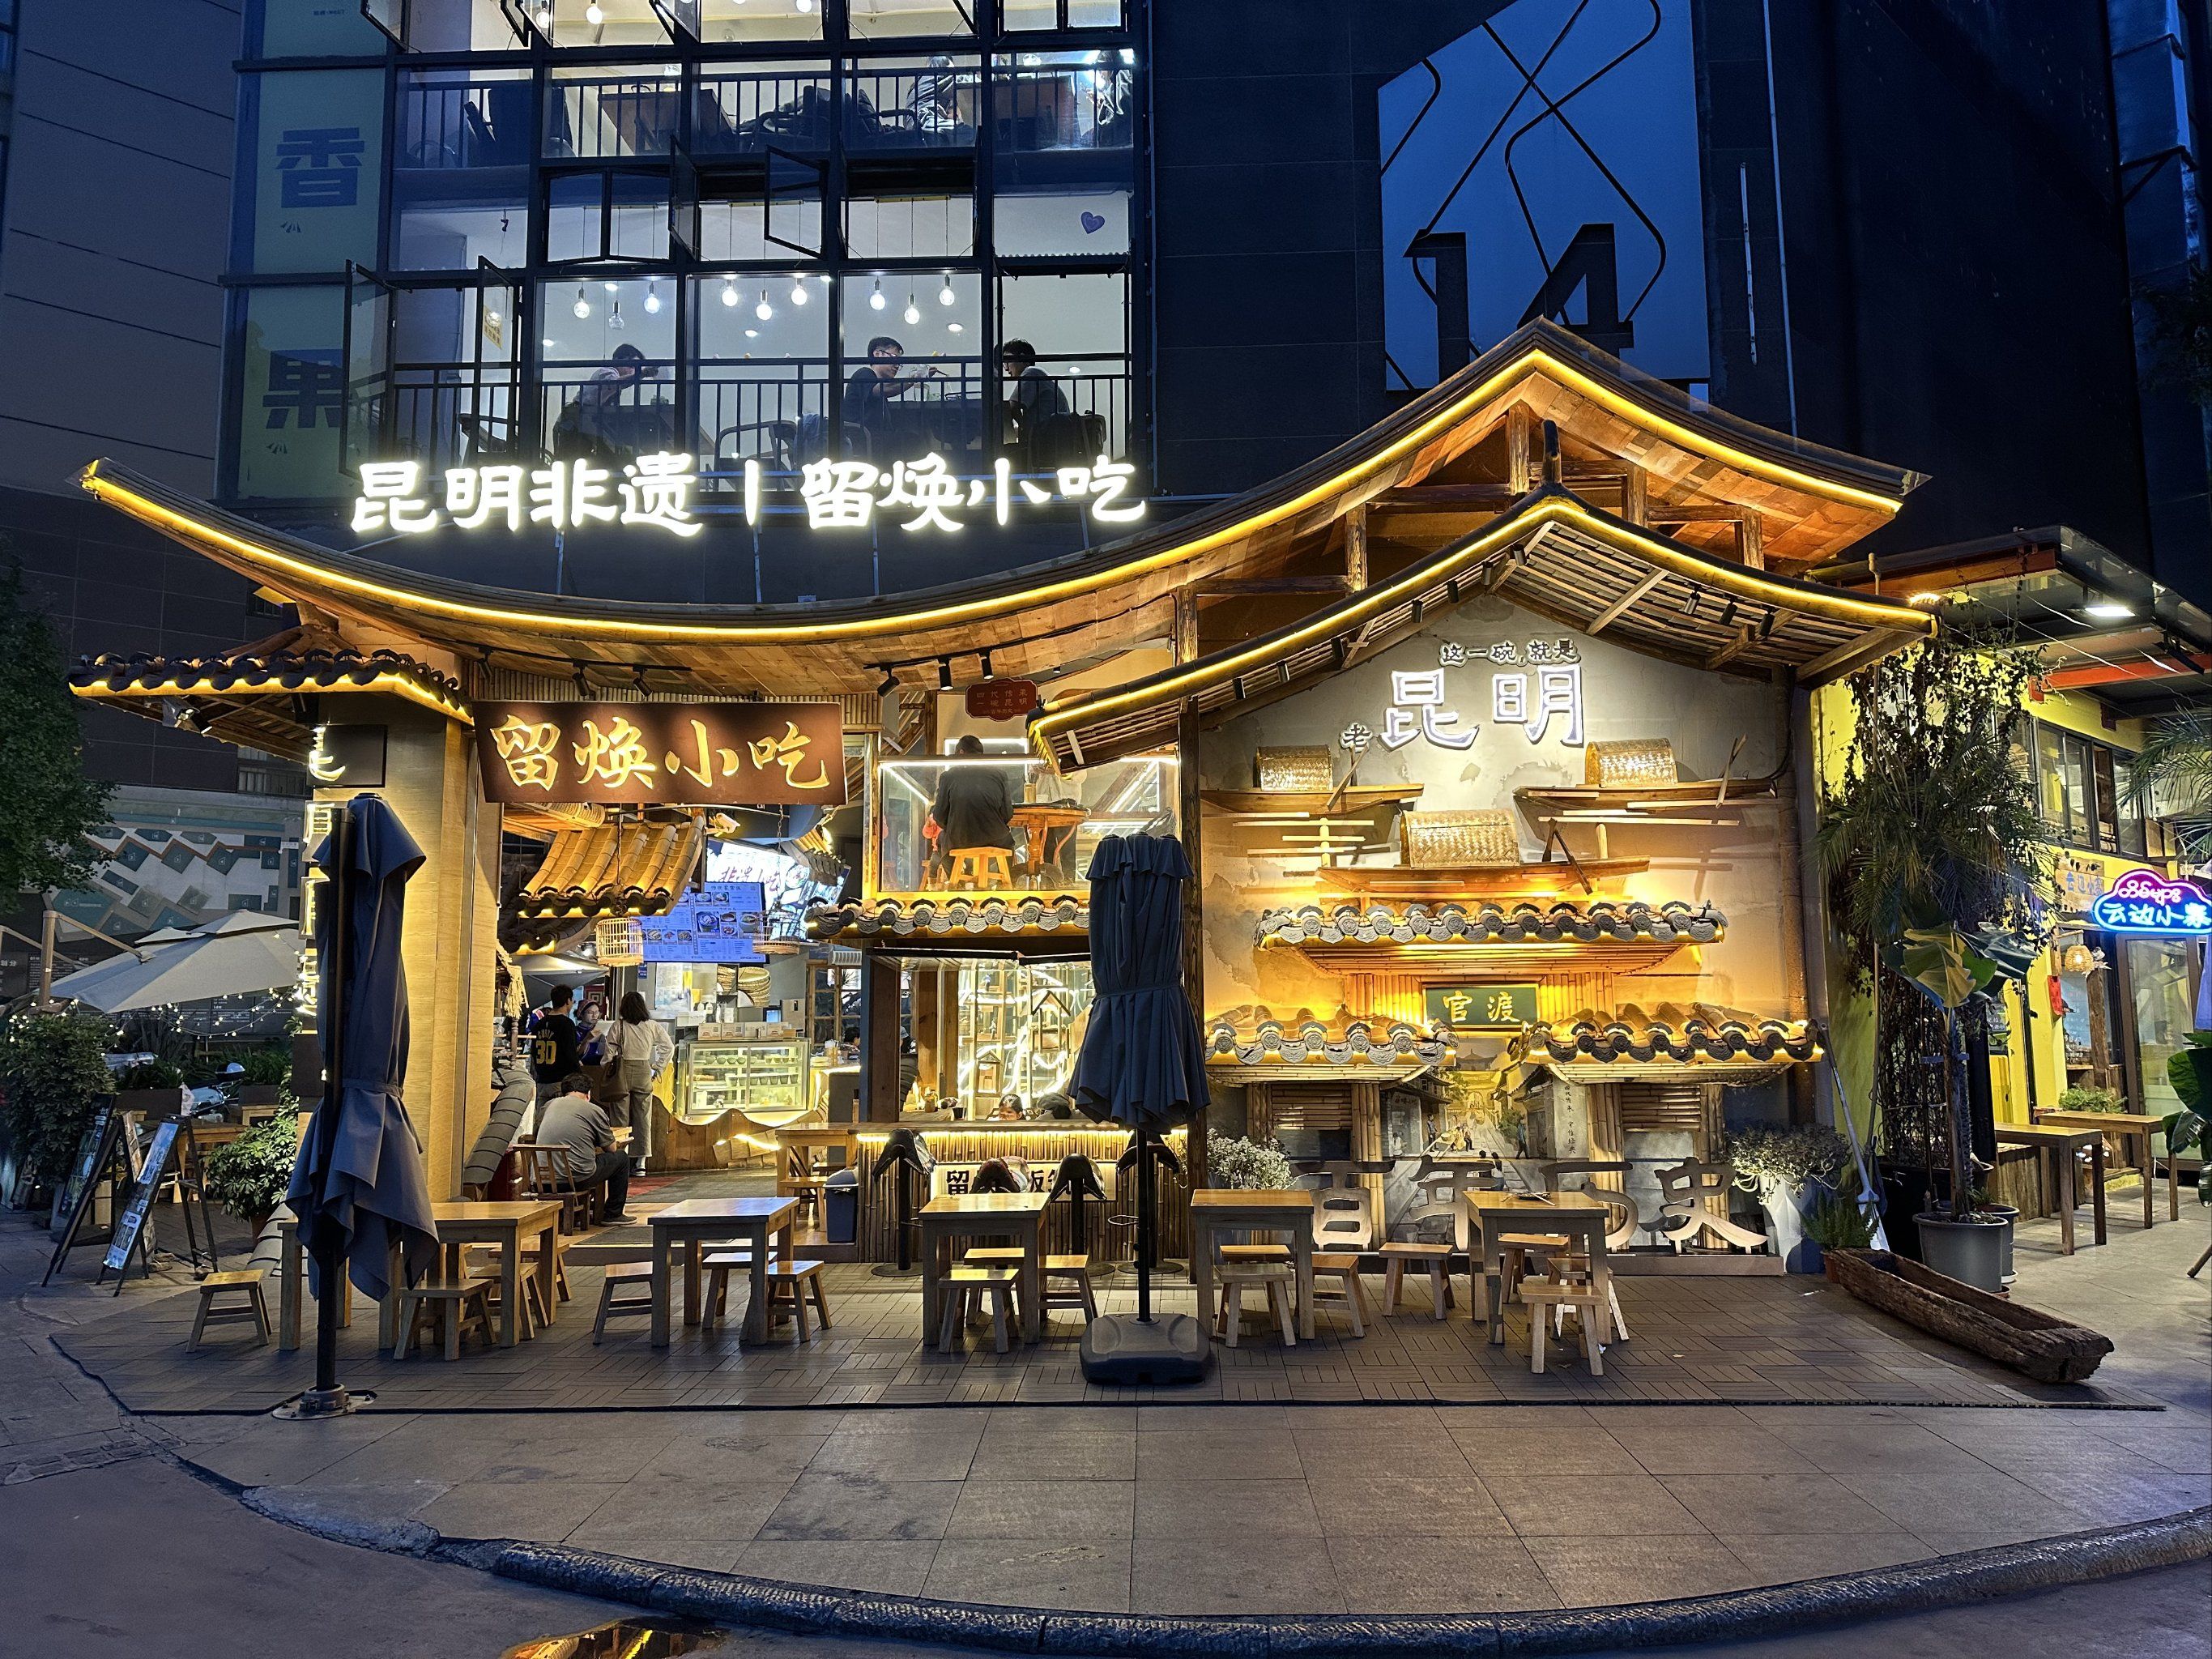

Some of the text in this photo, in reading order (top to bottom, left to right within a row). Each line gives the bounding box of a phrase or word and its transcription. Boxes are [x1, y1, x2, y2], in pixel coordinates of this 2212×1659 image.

[275, 126, 365, 208] 香
[1403, 224, 1634, 382] 14
[262, 348, 343, 429] 果
[351, 450, 704, 537] 昆明非遗
[799, 451, 1146, 532] 留焕小吃
[976, 689, 1028, 699] 四代传承
[976, 697, 1028, 707] 一碗昆明
[490, 714, 830, 791] 留焕小吃
[1443, 990, 1520, 1022] 官渡
[535, 1039, 557, 1064] 30
